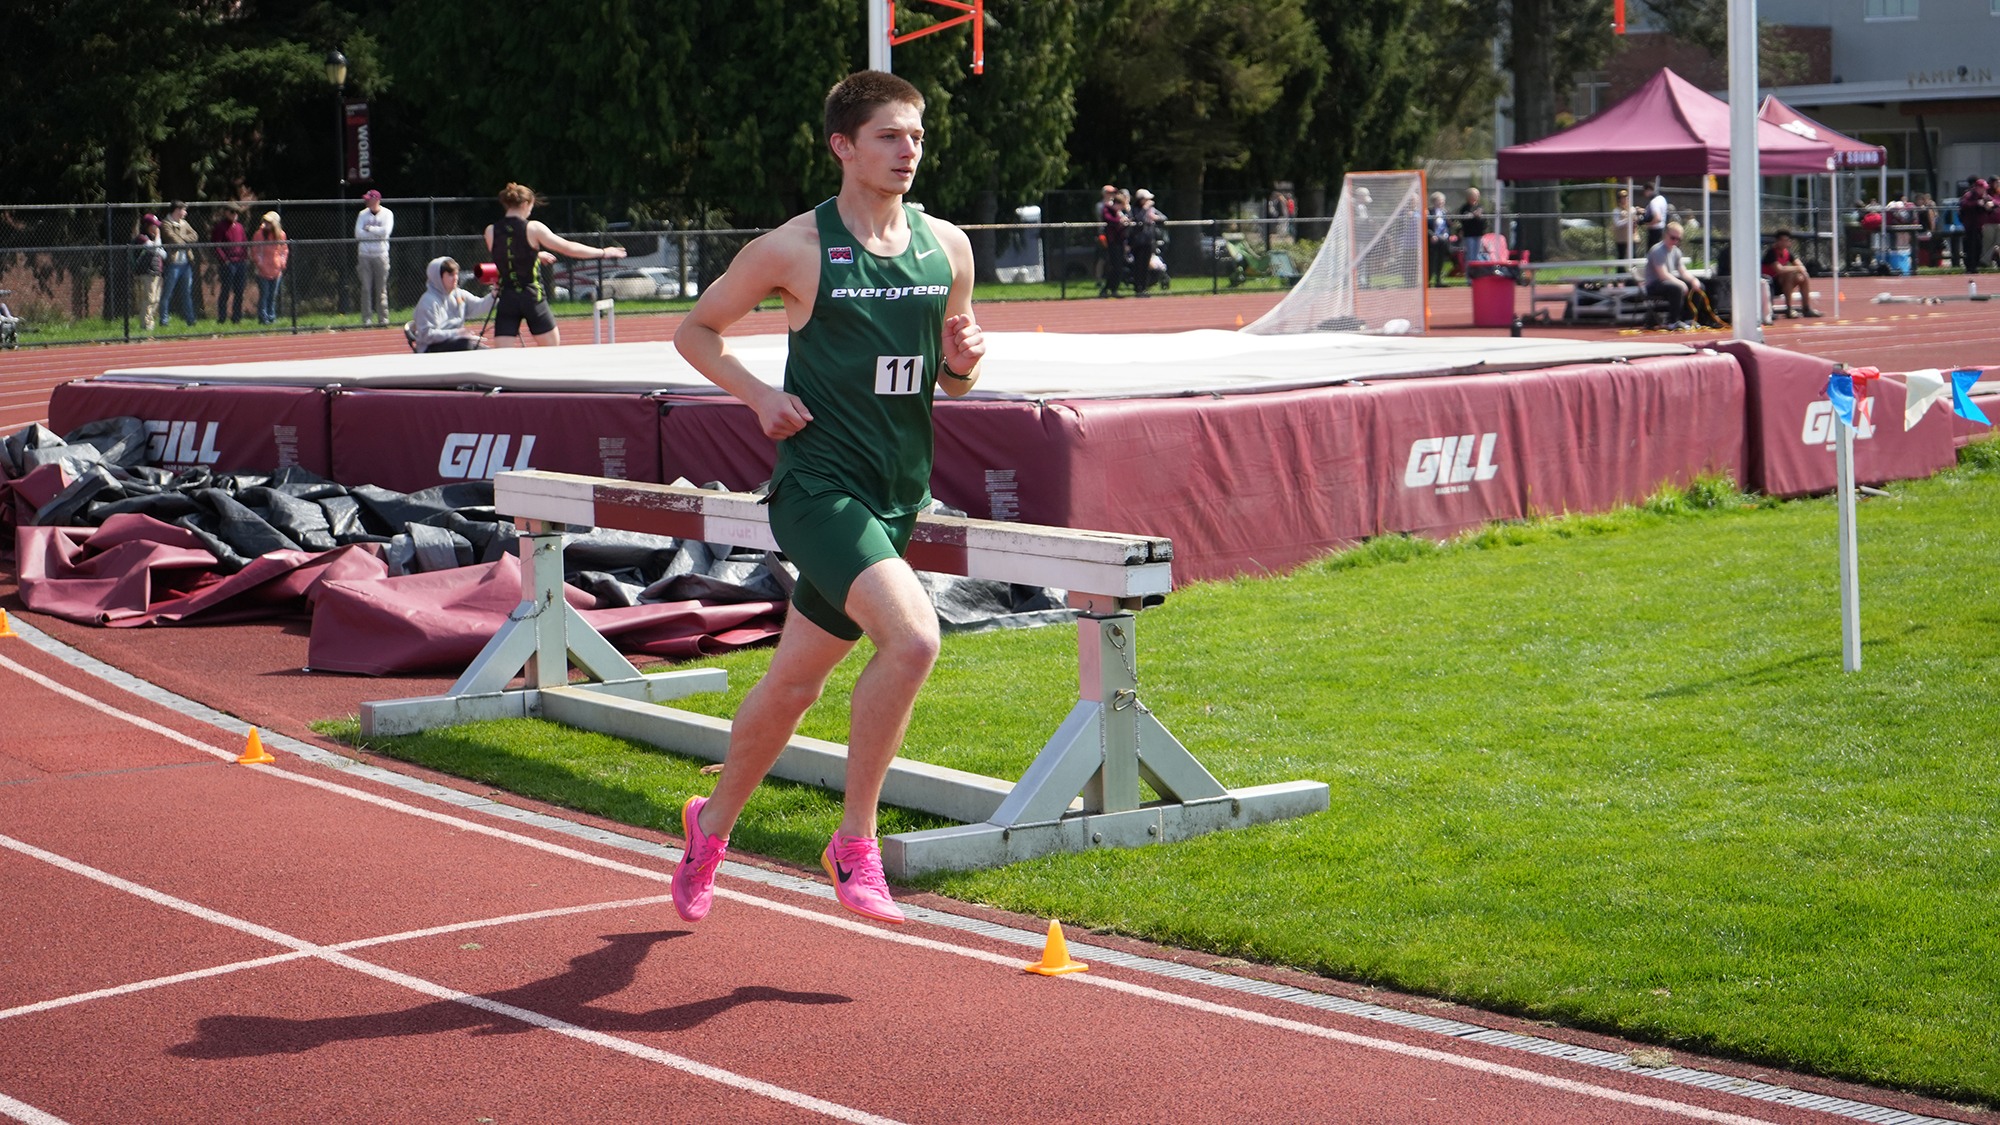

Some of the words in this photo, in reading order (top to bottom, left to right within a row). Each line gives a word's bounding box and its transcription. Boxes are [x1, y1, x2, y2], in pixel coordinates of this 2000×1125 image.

[358, 125, 370, 178] WORLD
[1847, 151, 1879, 164] SOUND
[831, 285, 949, 300] evergreen
[886, 358, 915, 392] 11
[143, 420, 222, 464] GILL
[438, 433, 537, 479] GILL
[1404, 432, 1499, 488] GILL
